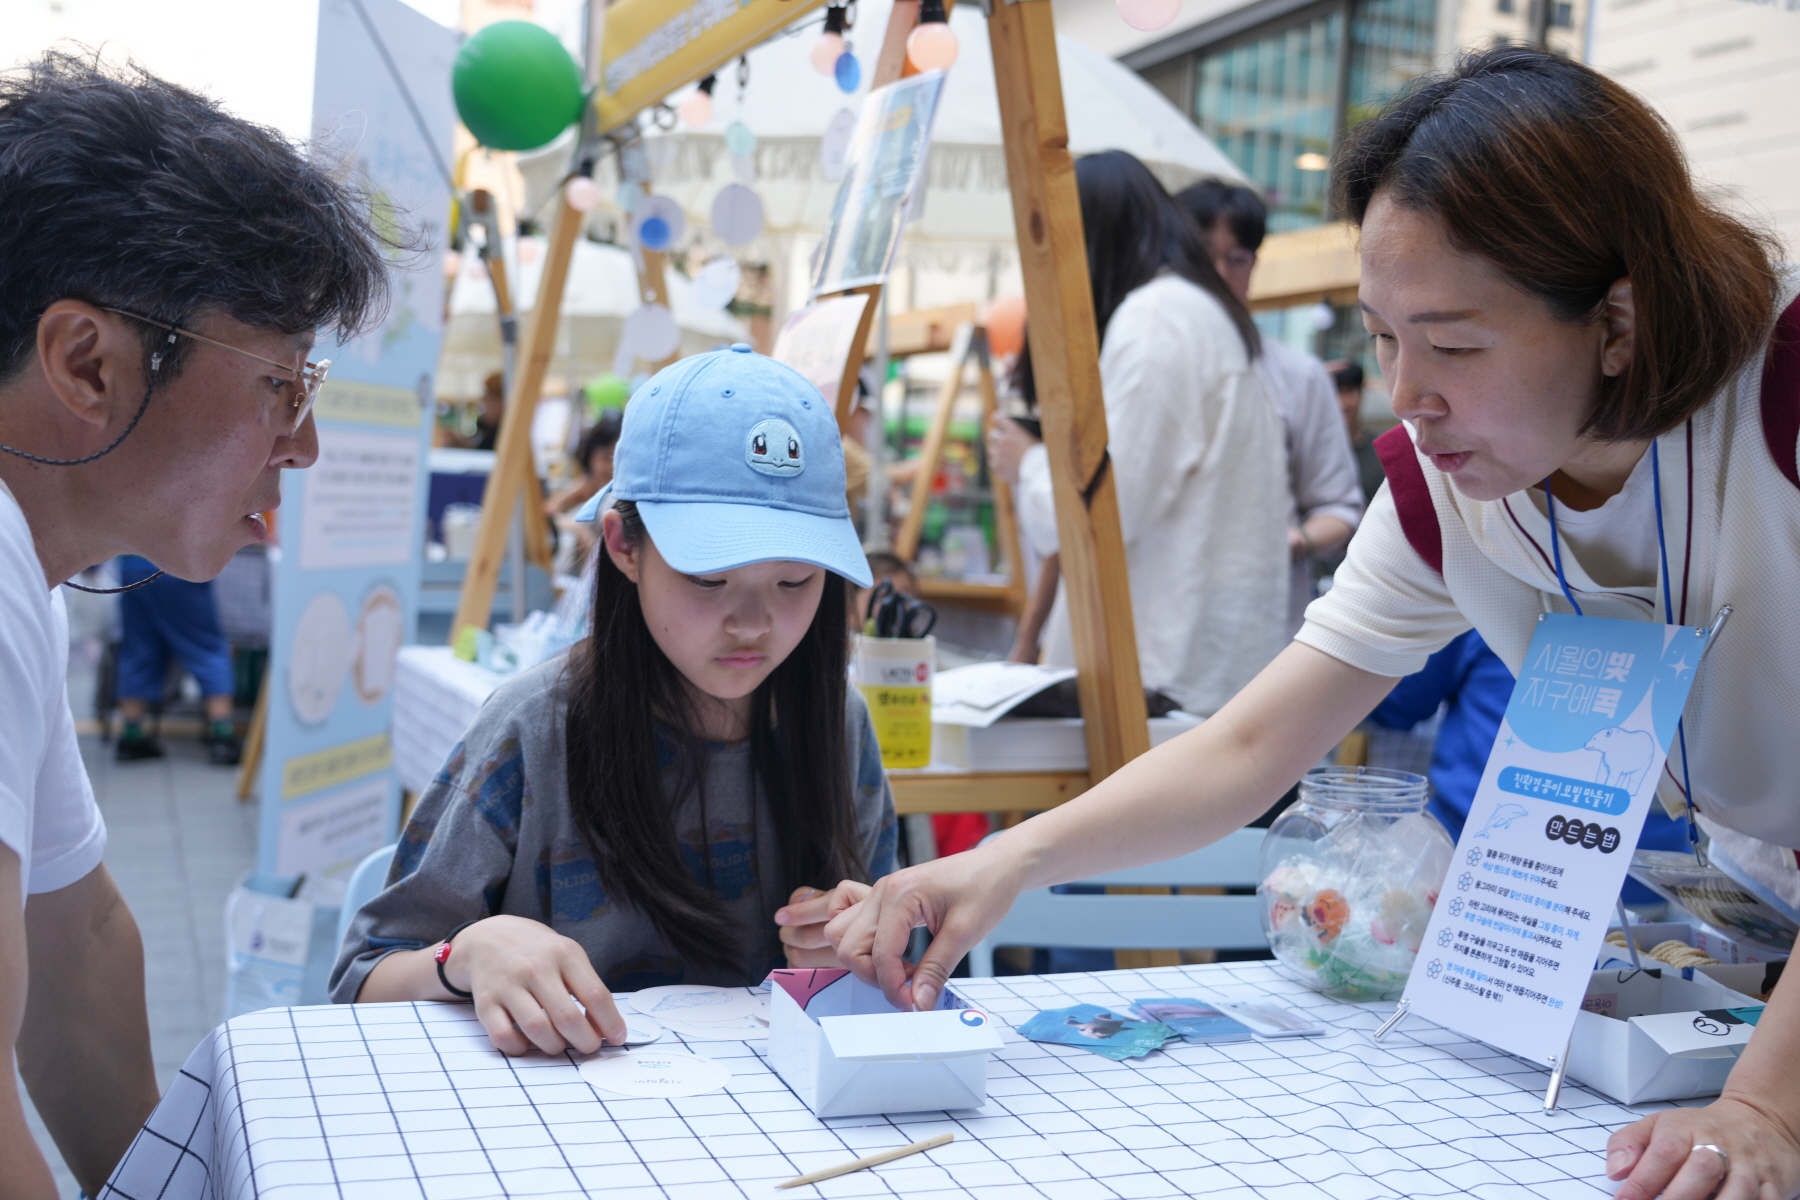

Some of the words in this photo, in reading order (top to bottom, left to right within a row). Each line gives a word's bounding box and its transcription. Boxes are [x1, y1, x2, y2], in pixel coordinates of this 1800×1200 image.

[1498, 851, 1510, 861] 위기
[1509, 855, 1522, 865] 해양
[1497, 886, 1509, 897] 모양
